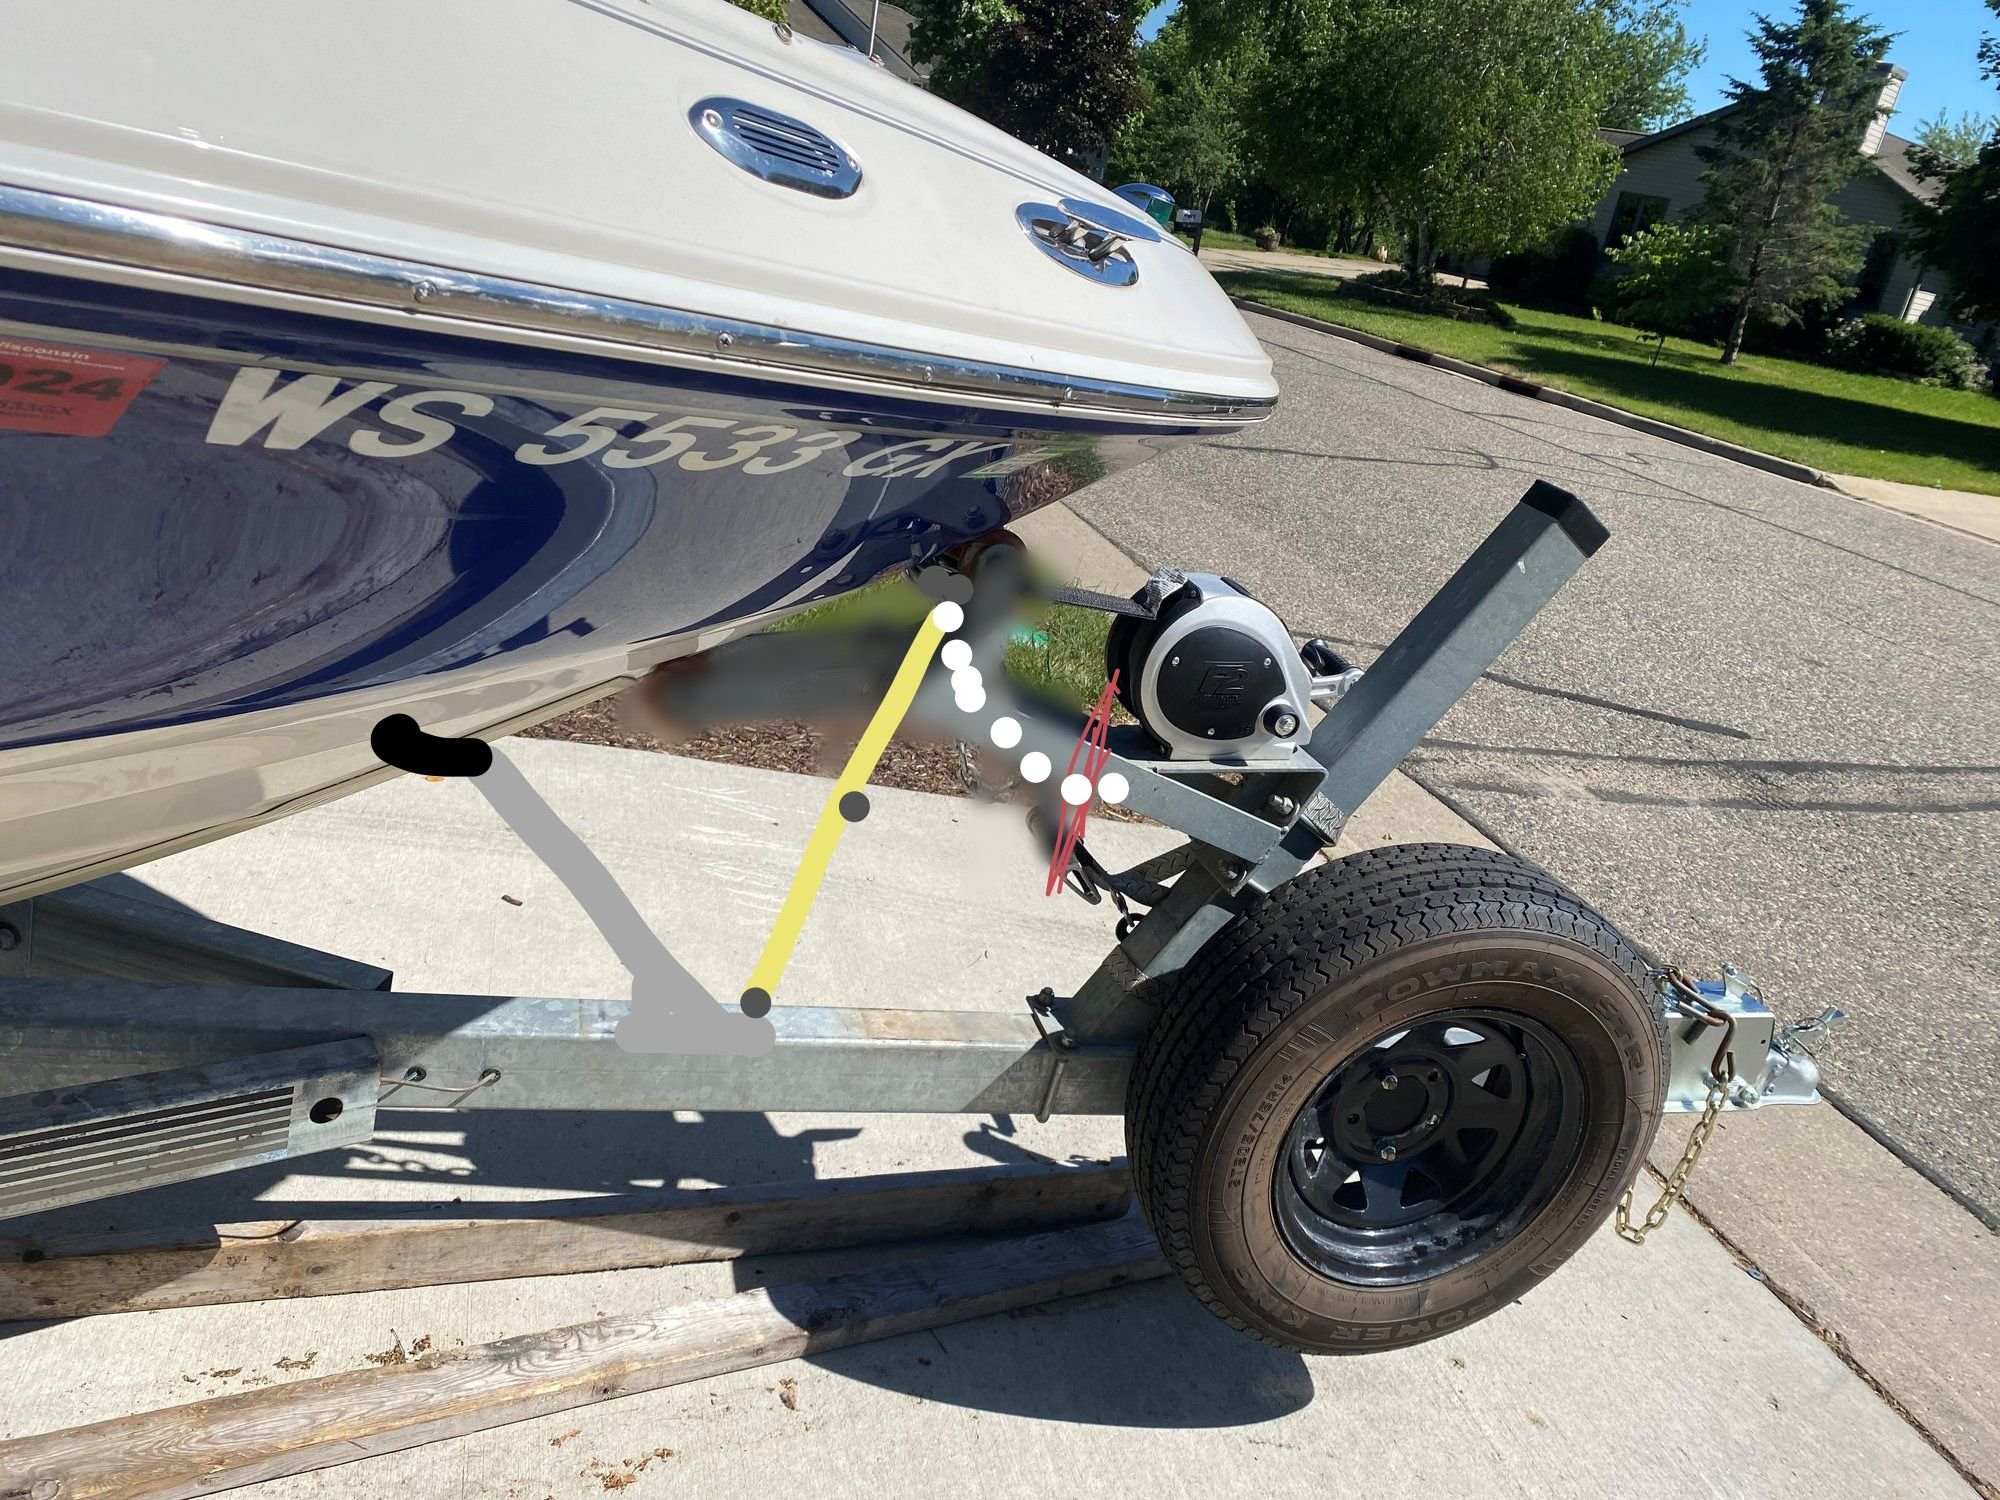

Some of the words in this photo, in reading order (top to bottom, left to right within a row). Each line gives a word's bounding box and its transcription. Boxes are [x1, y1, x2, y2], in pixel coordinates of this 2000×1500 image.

[0, 341, 91, 361] isconsin
[206, 366, 495, 458] WS
[514, 406, 863, 476] 5533
[842, 439, 1012, 478] GX
[1344, 960, 1581, 1019] TOWMAX
[1231, 1266, 1310, 1330] KING
[1328, 1293, 1497, 1341] POWER
